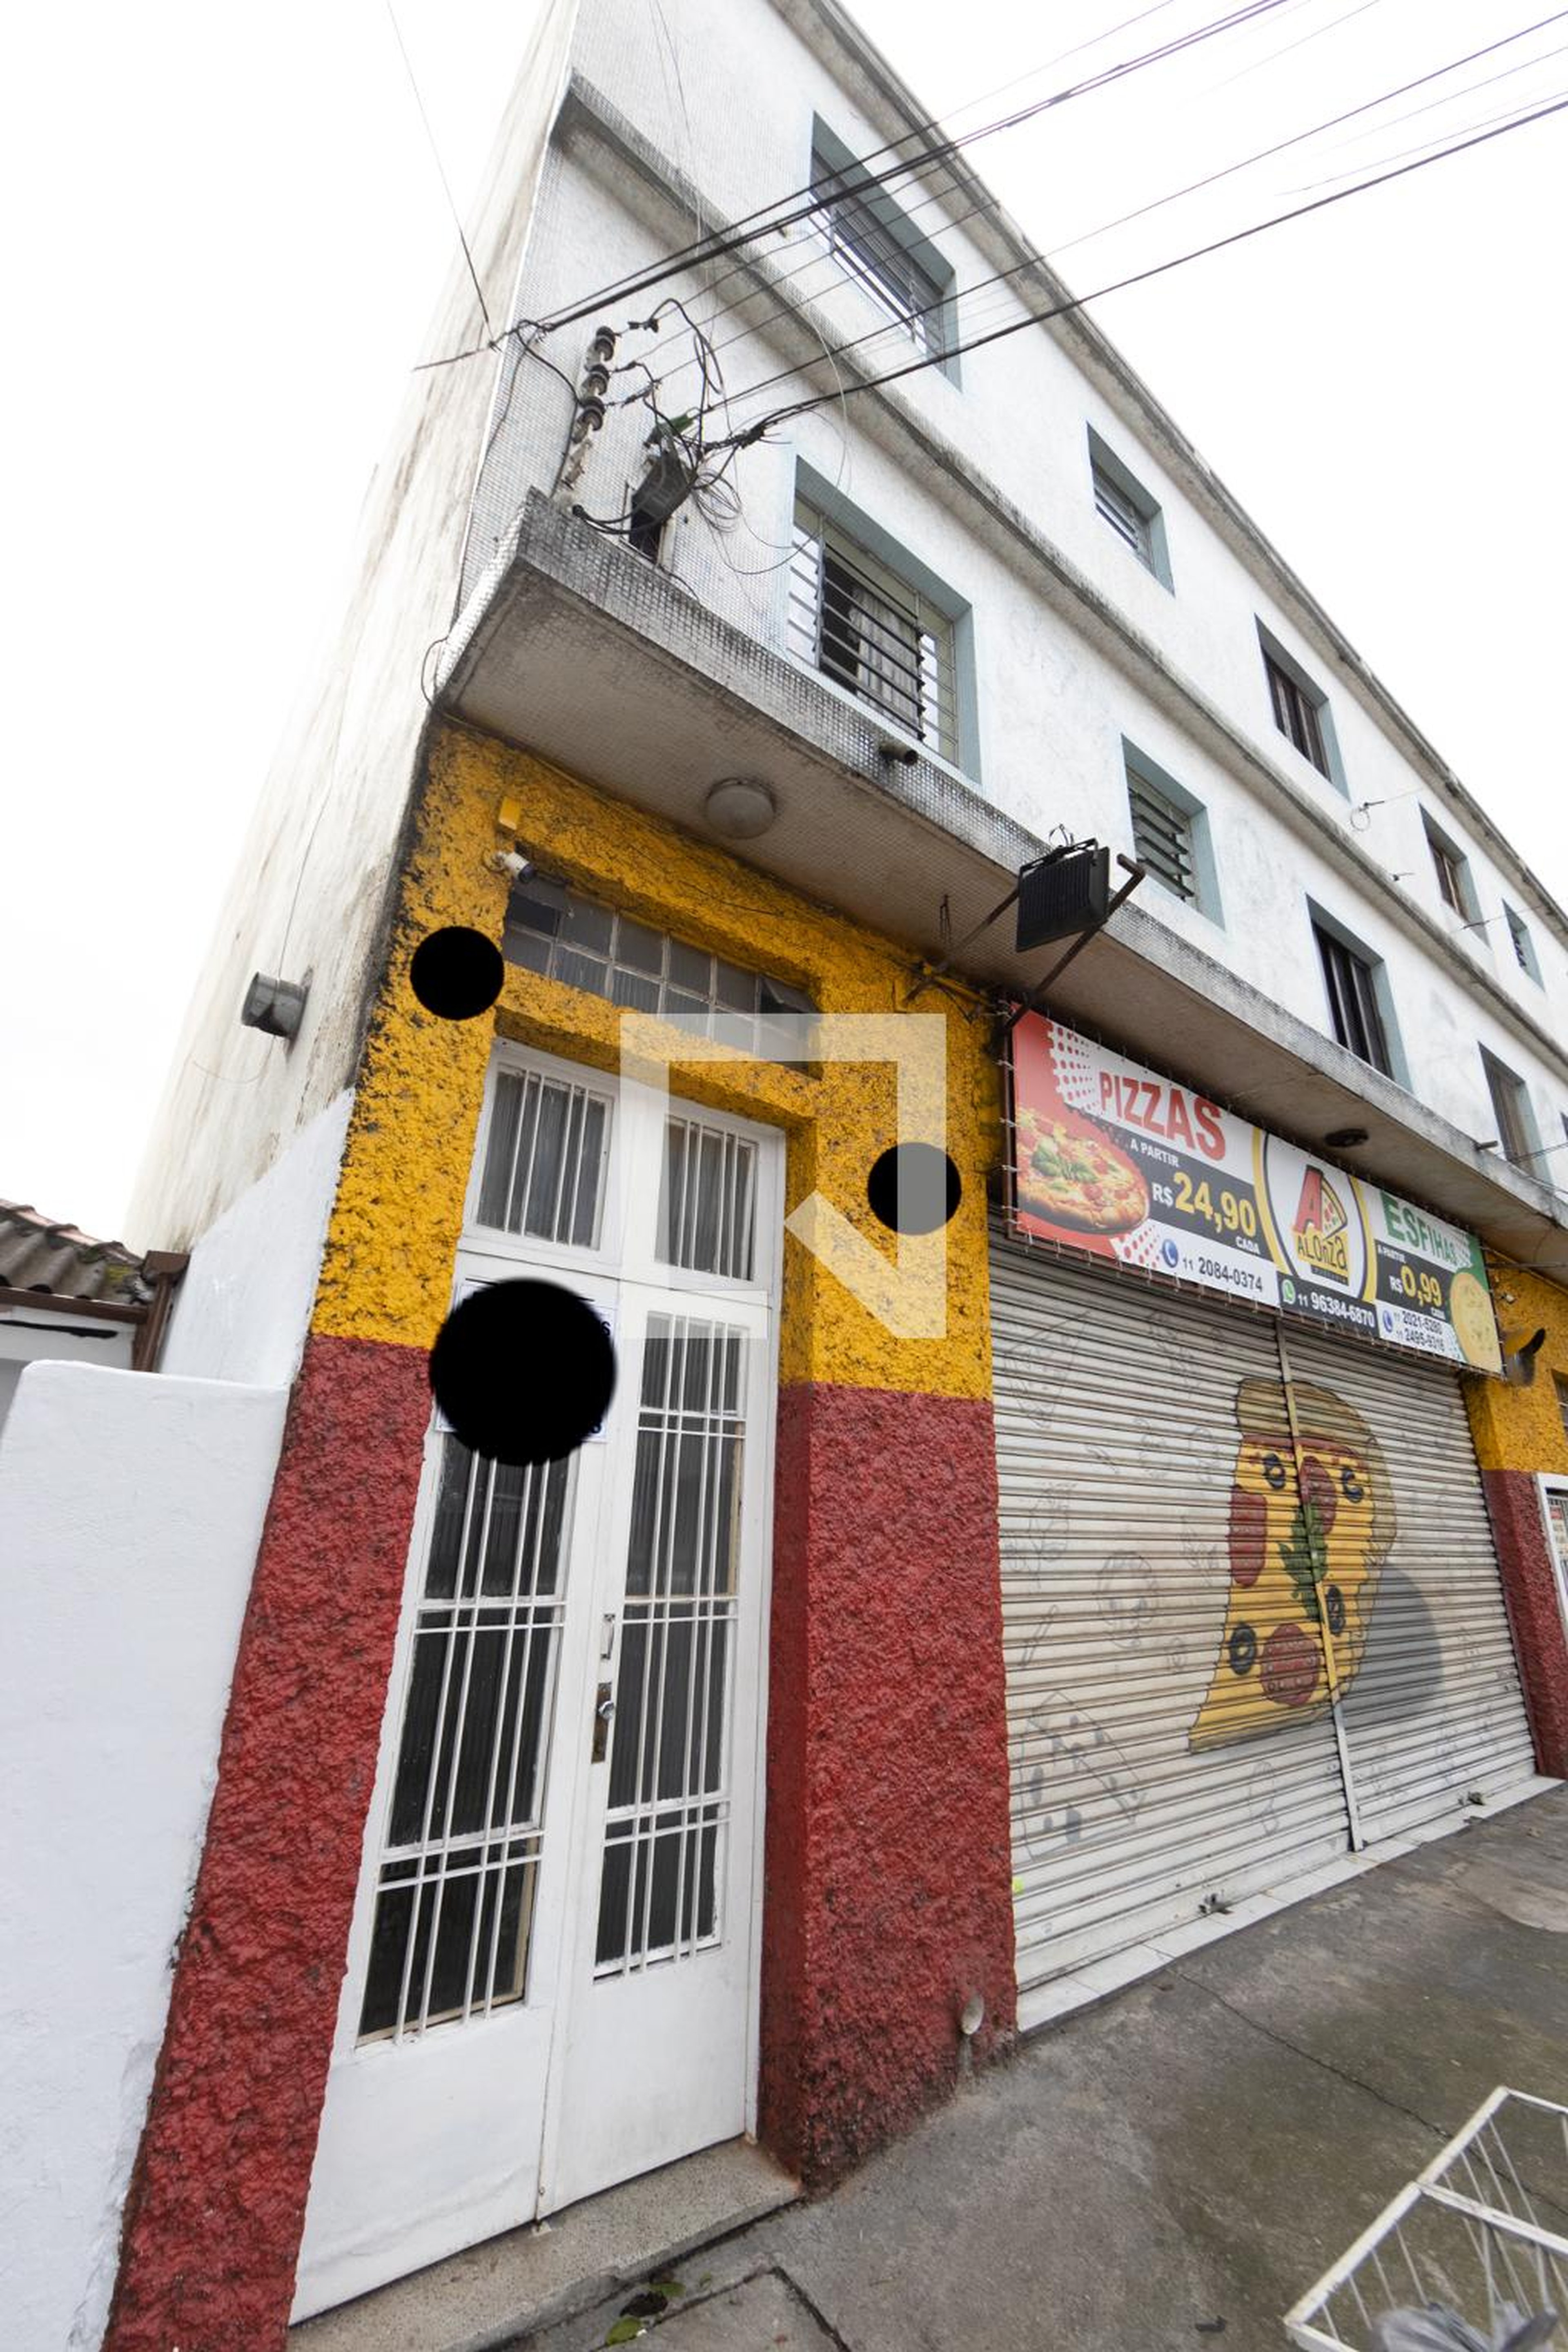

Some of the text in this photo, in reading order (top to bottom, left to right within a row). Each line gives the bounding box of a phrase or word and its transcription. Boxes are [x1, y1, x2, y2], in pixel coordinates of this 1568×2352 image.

[1100, 1071, 1225, 1161] PIZZAS
[1130, 1138, 1179, 1167] A PARTIR
[1152, 1171, 1256, 1238] R$ 24,90
[1183, 1256, 1263, 1292] 11 2084-0374
[1401, 1265, 1441, 1307] 0,99
[1298, 1294, 1308, 1307] 11
